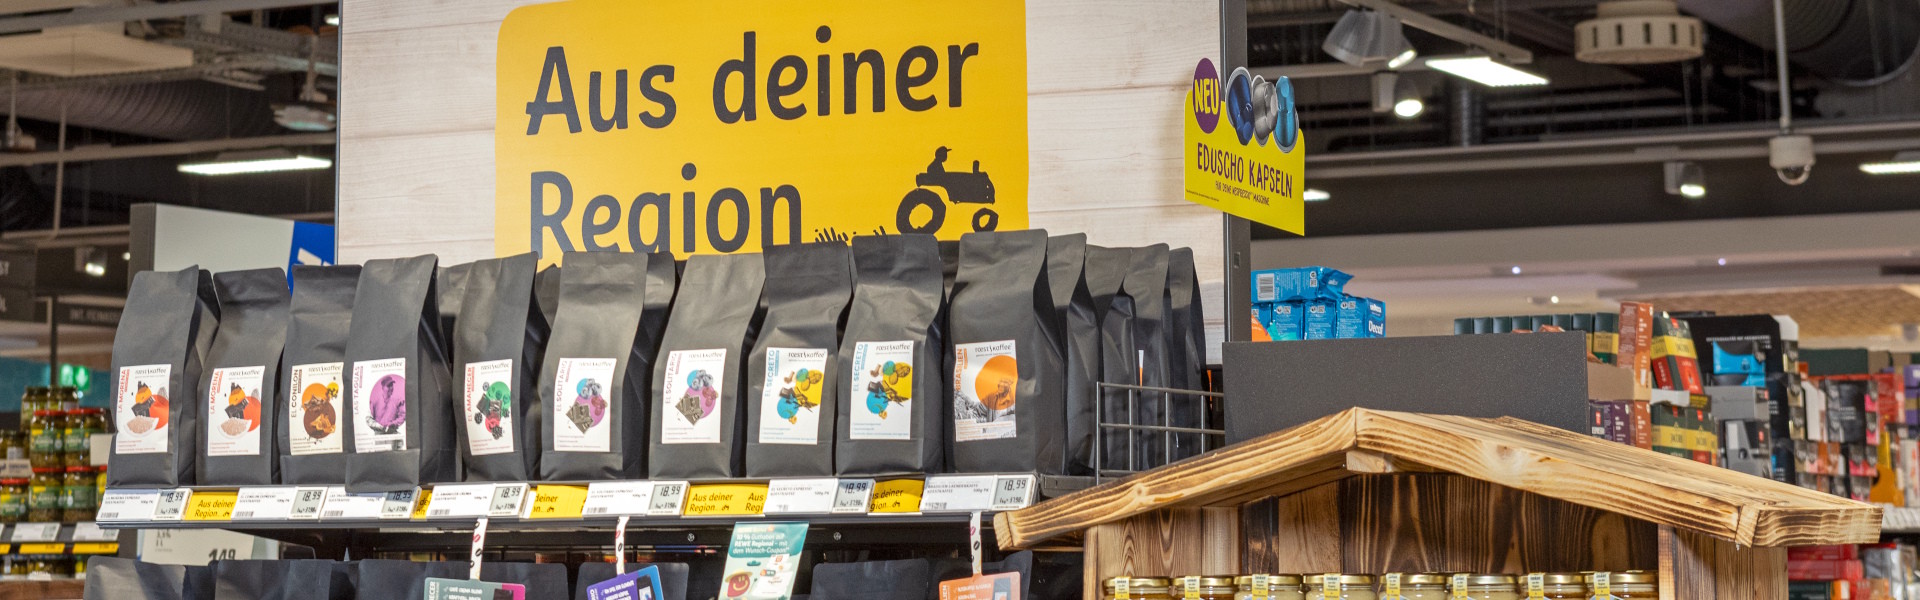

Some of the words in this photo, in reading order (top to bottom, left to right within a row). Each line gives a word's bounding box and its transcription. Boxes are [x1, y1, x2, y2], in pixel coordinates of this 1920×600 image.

[526, 46, 676, 136] Aus
[713, 26, 979, 124] deiner
[1194, 77, 1220, 116] NEU
[1197, 142, 1244, 183] EDUSCHO
[1249, 158, 1293, 198] KAPSELN
[530, 162, 802, 258] Region
[853, 343, 864, 382] SECRETO
[766, 350, 775, 388] SECRETO
[119, 369, 127, 403] MORENA
[211, 370, 220, 404] MORENA
[291, 368, 299, 408] CONILON
[660, 485, 681, 497] 18.99
[845, 482, 866, 494] 18.99
[1004, 479, 1027, 491] 18.99
[165, 492, 183, 502] 18.99
[302, 491, 321, 502] 18.99
[392, 490, 412, 500] 18.99
[501, 487, 520, 498] 18.99
[692, 493, 707, 502] Aus
[709, 492, 734, 501] deiner
[748, 492, 765, 502] Aus
[880, 488, 904, 499] deiner
[197, 499, 210, 508] Aus
[212, 499, 234, 507] deiner
[689, 503, 716, 514] Region
[745, 502, 764, 514] Regi
[194, 508, 218, 518] Region
[751, 540, 774, 548] Regional
